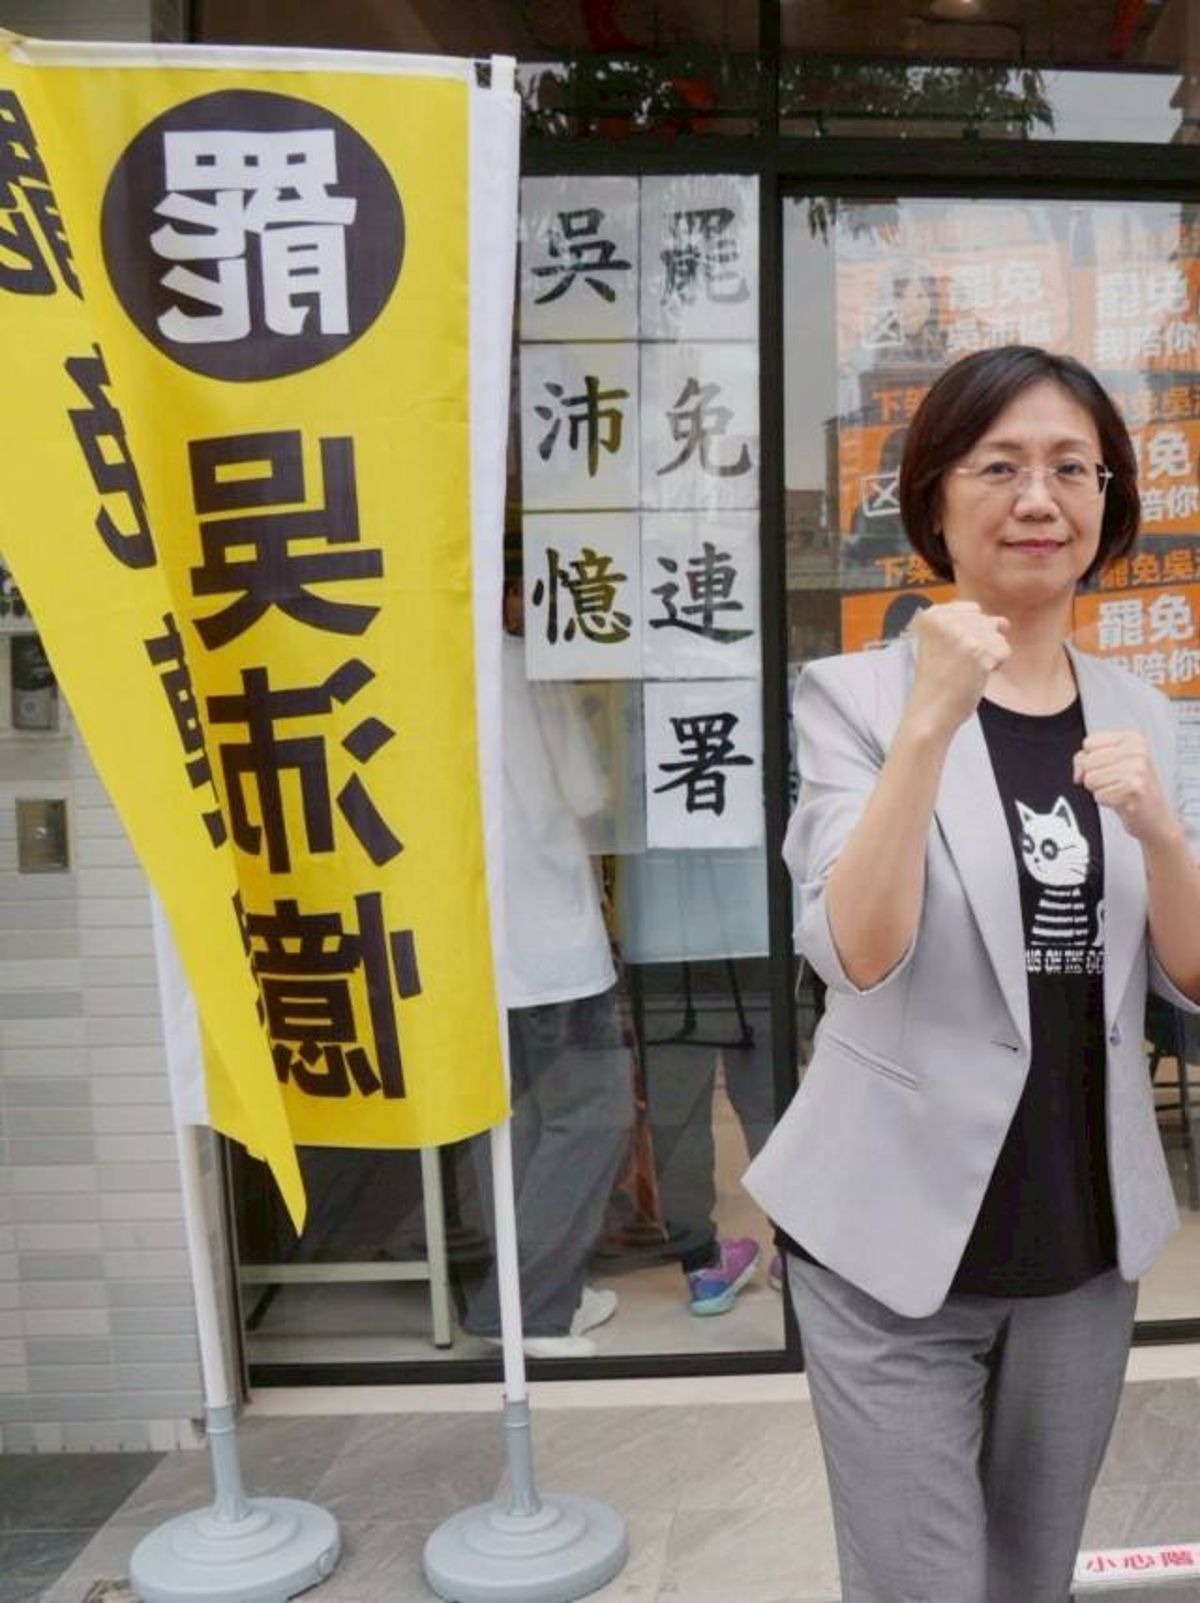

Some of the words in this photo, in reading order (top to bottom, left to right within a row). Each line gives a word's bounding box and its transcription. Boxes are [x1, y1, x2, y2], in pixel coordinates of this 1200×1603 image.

[532, 208, 633, 645] 吳沛憶
[648, 207, 756, 816] 罷免連署
[1098, 594, 1195, 652] 罷免
